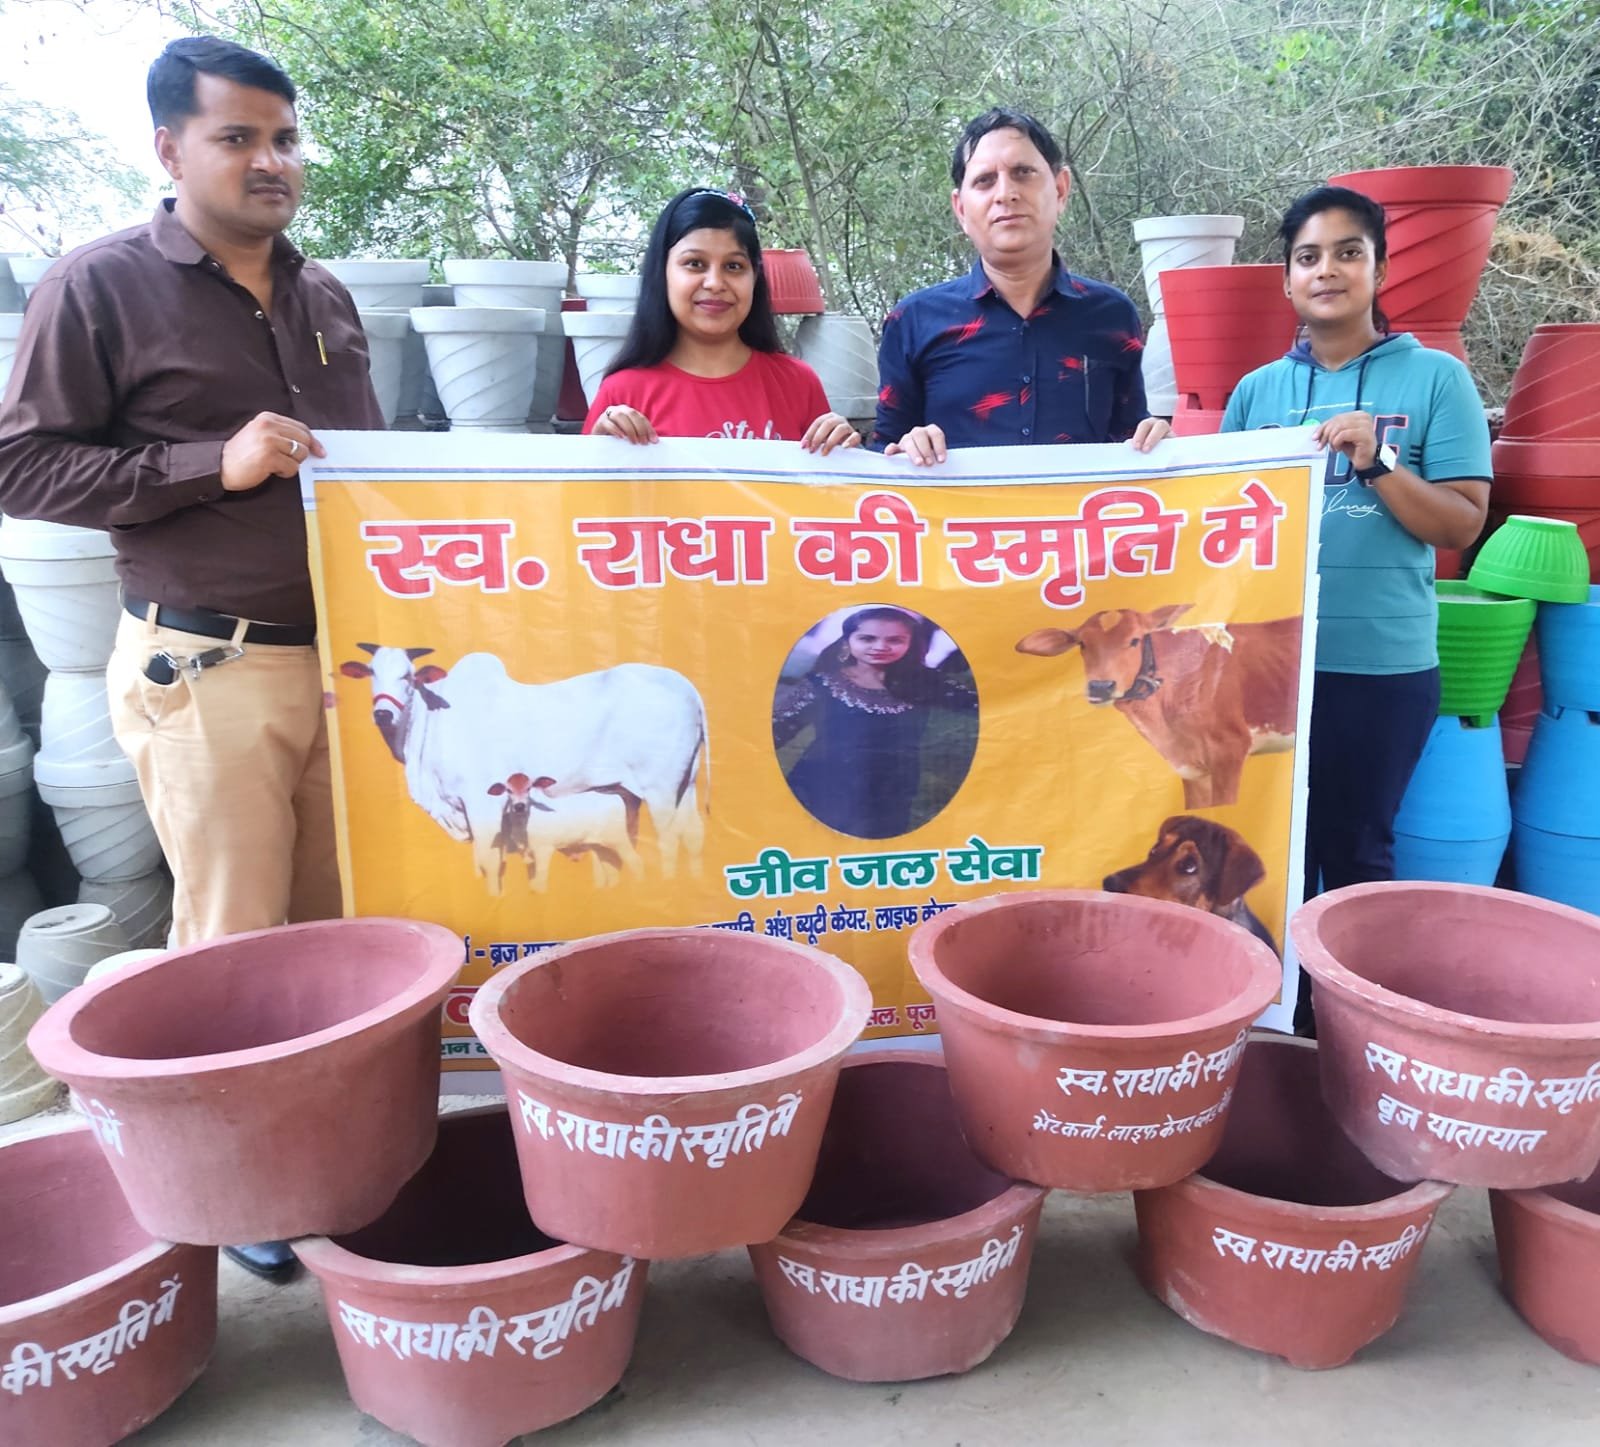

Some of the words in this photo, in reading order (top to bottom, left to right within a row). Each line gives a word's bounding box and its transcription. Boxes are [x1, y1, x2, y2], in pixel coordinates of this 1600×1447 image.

[362, 518, 549, 599] स्व.
[573, 518, 775, 591] राधा
[791, 490, 928, 586] की
[945, 487, 1189, 608] स्मृति
[1200, 478, 1288, 571] मे
[724, 848, 830, 900] जीव
[839, 849, 940, 888] जल
[947, 835, 1045, 885] सेवा
[875, 905, 919, 930] लाइफ
[1485, 1067, 1534, 1108] की
[629, 1114, 682, 1163] की
[680, 1103, 773, 1169] स्मृति
[1427, 1112, 1547, 1155] यातायात
[887, 1262, 933, 1304] की
[1324, 1240, 1362, 1273] की
[454, 1306, 506, 1362] की
[503, 1275, 610, 1361] स्मृति
[0, 1342, 56, 1395] की
[57, 1299, 157, 1380] स्मृति
